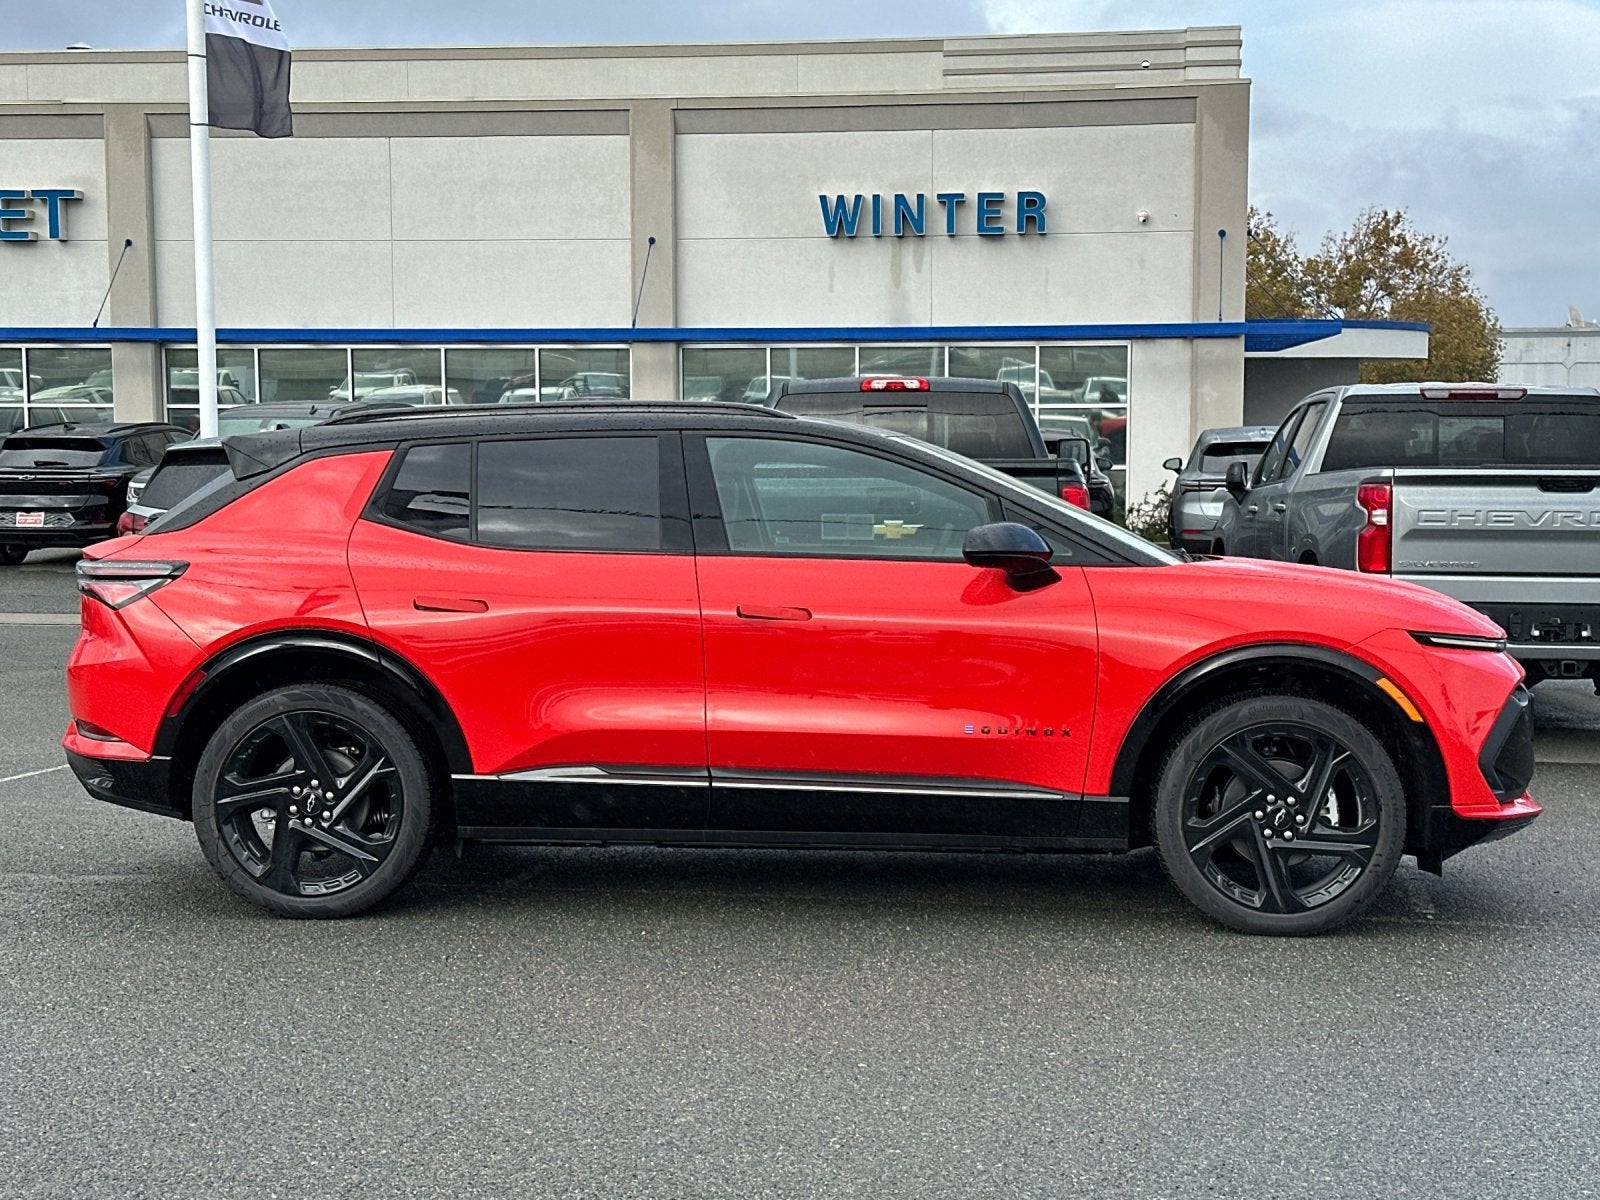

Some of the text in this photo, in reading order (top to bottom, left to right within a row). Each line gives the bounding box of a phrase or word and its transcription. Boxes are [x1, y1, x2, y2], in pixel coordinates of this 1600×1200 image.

[818, 190, 1048, 238] WINTER
[1399, 560, 1481, 568] SILVERADO
[963, 724, 1072, 738] EQUINOX
